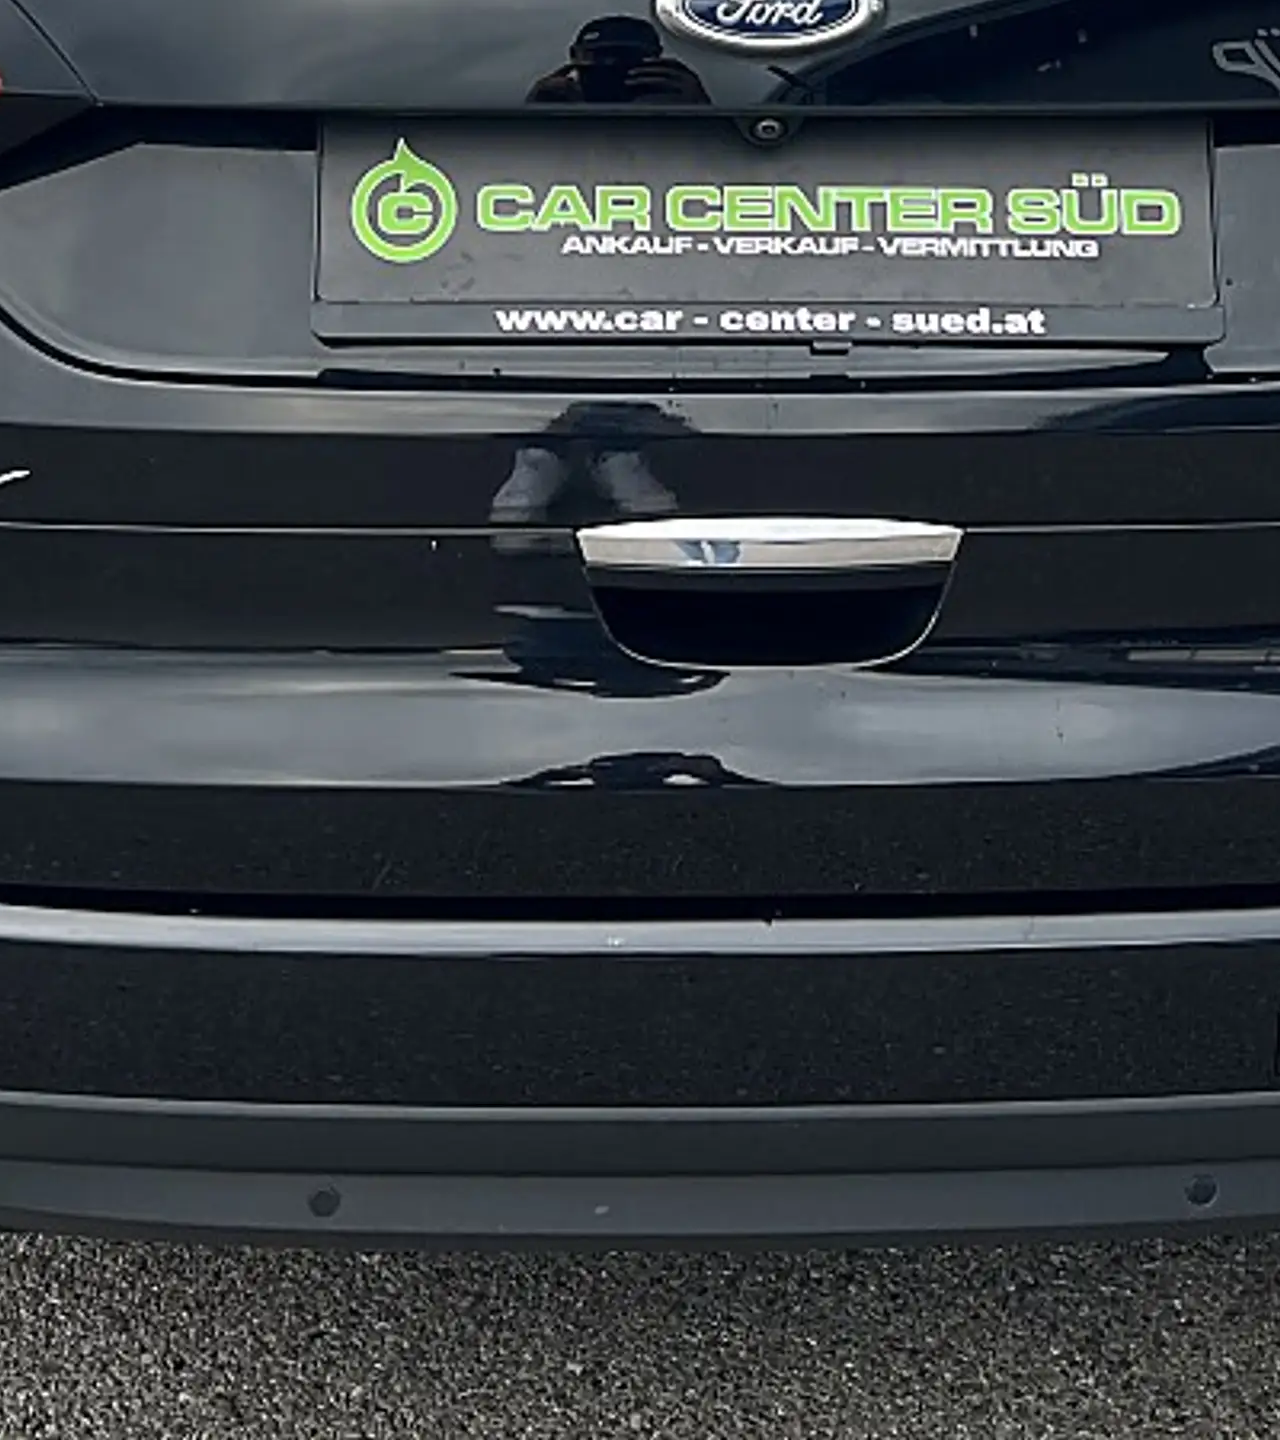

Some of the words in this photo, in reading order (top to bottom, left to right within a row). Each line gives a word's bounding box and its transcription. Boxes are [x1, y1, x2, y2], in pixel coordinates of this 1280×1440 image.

[476, 184, 652, 232] CAR
[664, 185, 995, 235] CENTER
[1007, 172, 1183, 236] SÜD
[561, 236, 694, 255] ANKAUF
[712, 236, 860, 256] VERKAUF
[878, 237, 1100, 259] VERMITTLUNG
[719, 307, 857, 334] center
[891, 306, 1048, 335] sued.at
